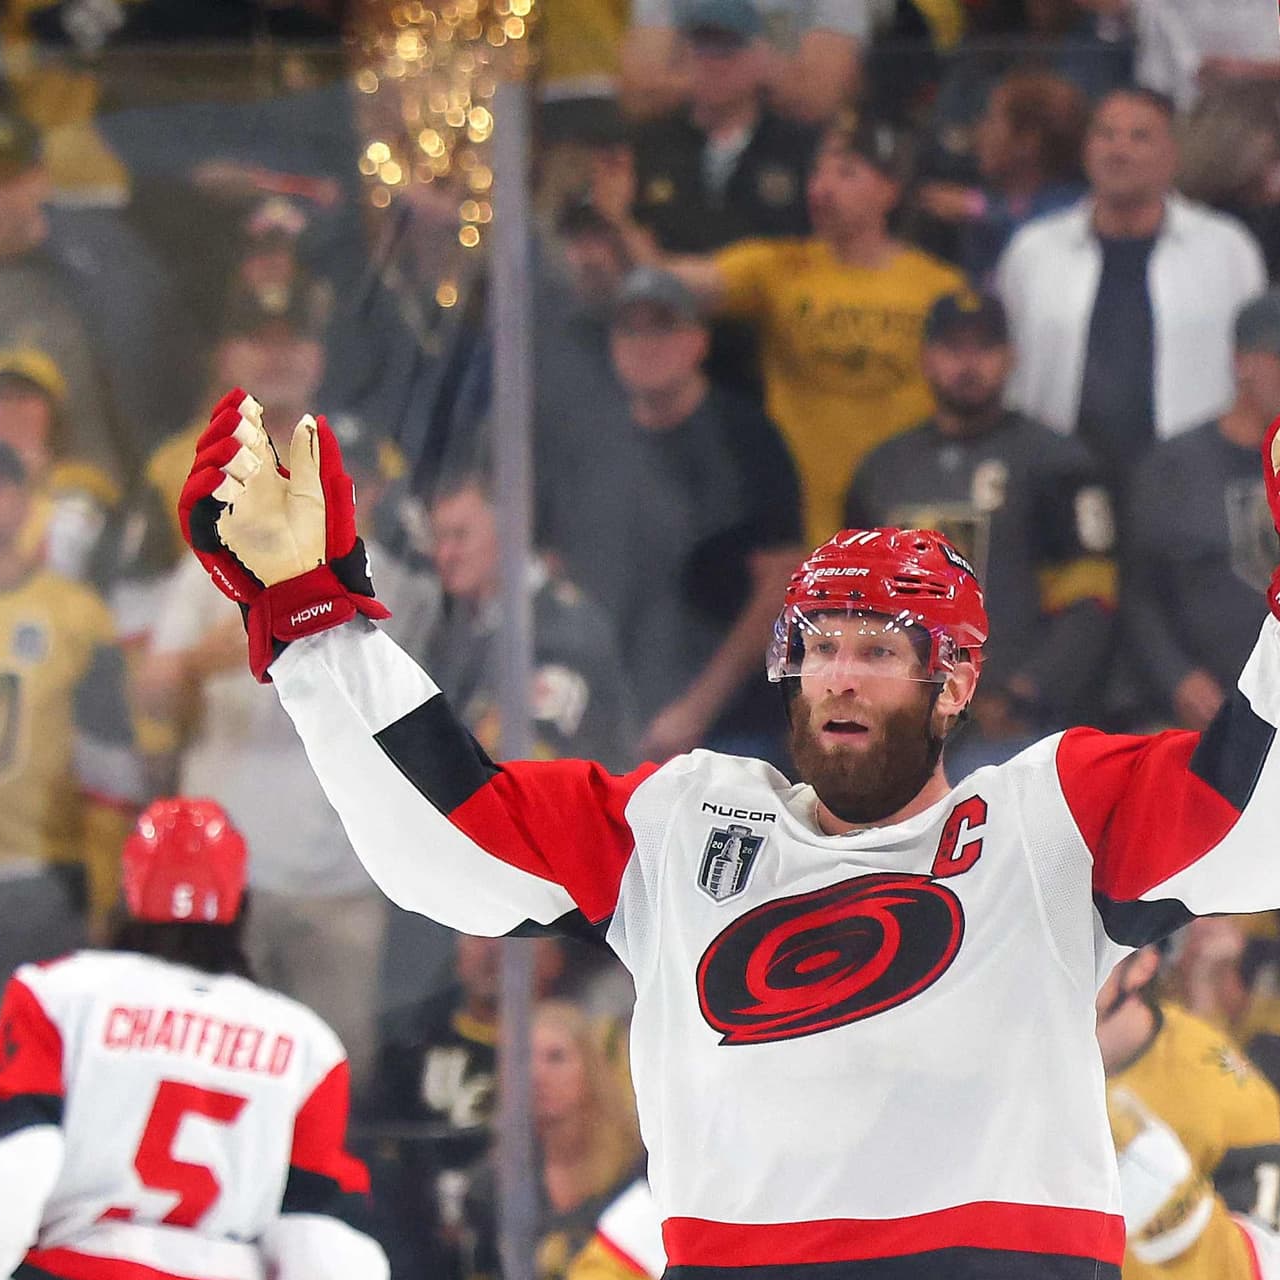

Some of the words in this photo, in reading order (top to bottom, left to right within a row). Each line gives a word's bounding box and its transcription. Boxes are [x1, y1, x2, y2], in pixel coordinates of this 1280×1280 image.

[813, 566, 870, 578] BAUER
[290, 601, 333, 627] MACH
[701, 801, 777, 823] NUCOR
[711, 840, 724, 850] 20
[930, 793, 989, 879] C
[102, 1005, 296, 1078] CHATFIELD
[96, 1079, 249, 1230] 5
